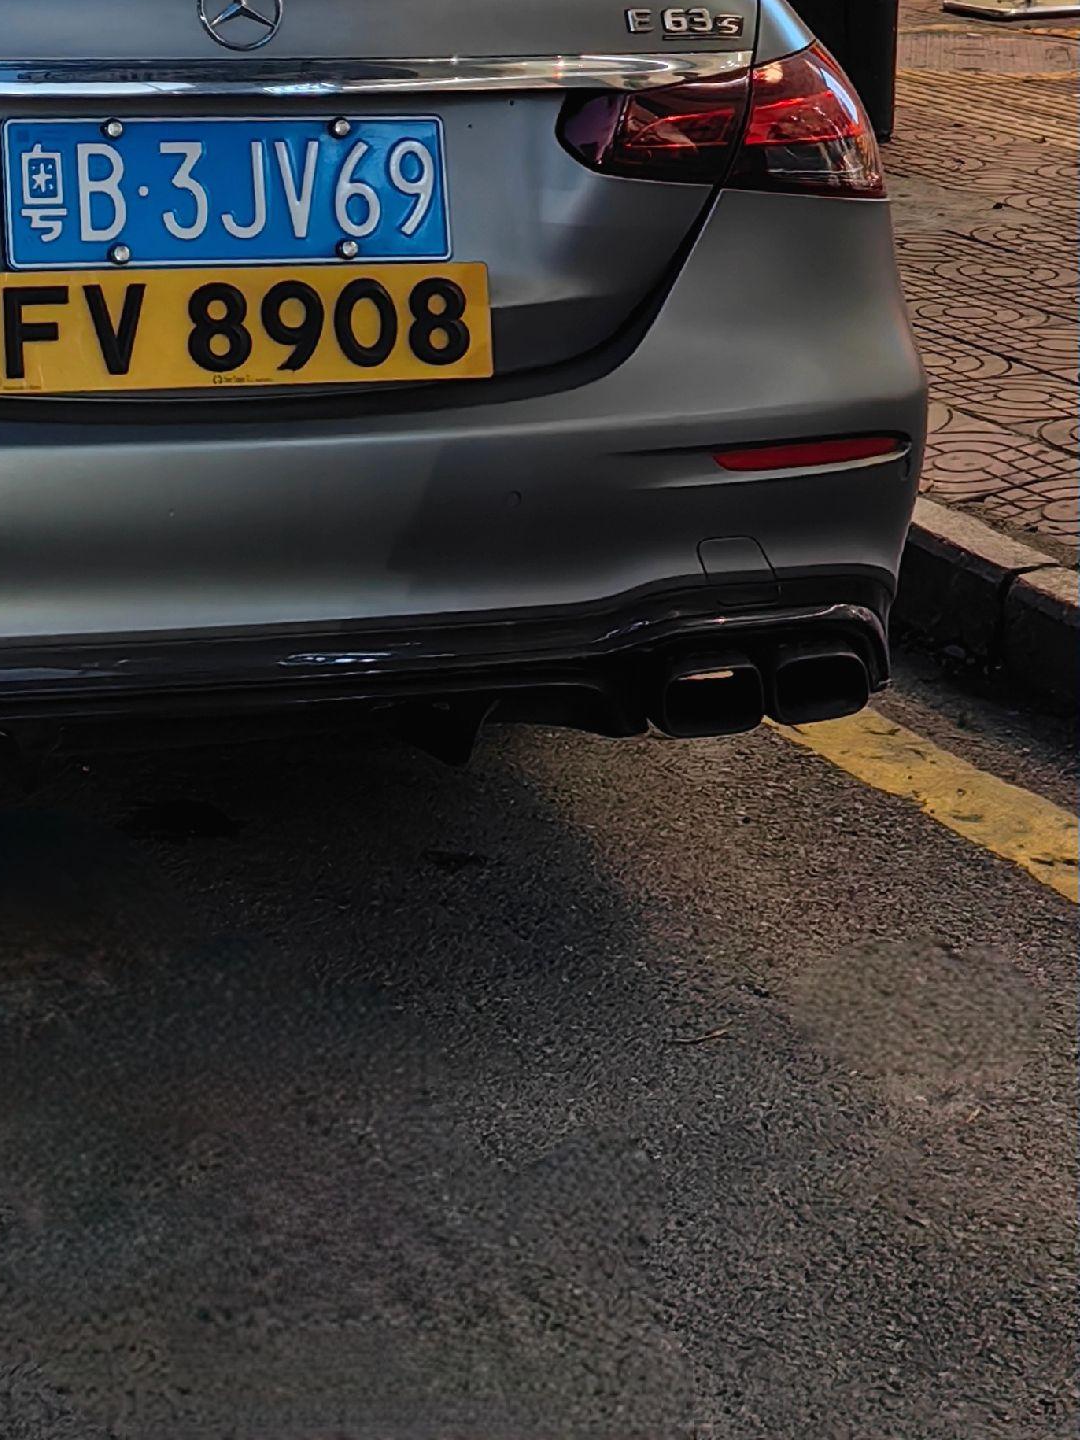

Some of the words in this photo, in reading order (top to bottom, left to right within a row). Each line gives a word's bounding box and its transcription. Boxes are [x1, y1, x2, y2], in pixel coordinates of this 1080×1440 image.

[624, 8, 654, 34] E
[2, 283, 147, 379] FV
[187, 277, 471, 373] 8908
